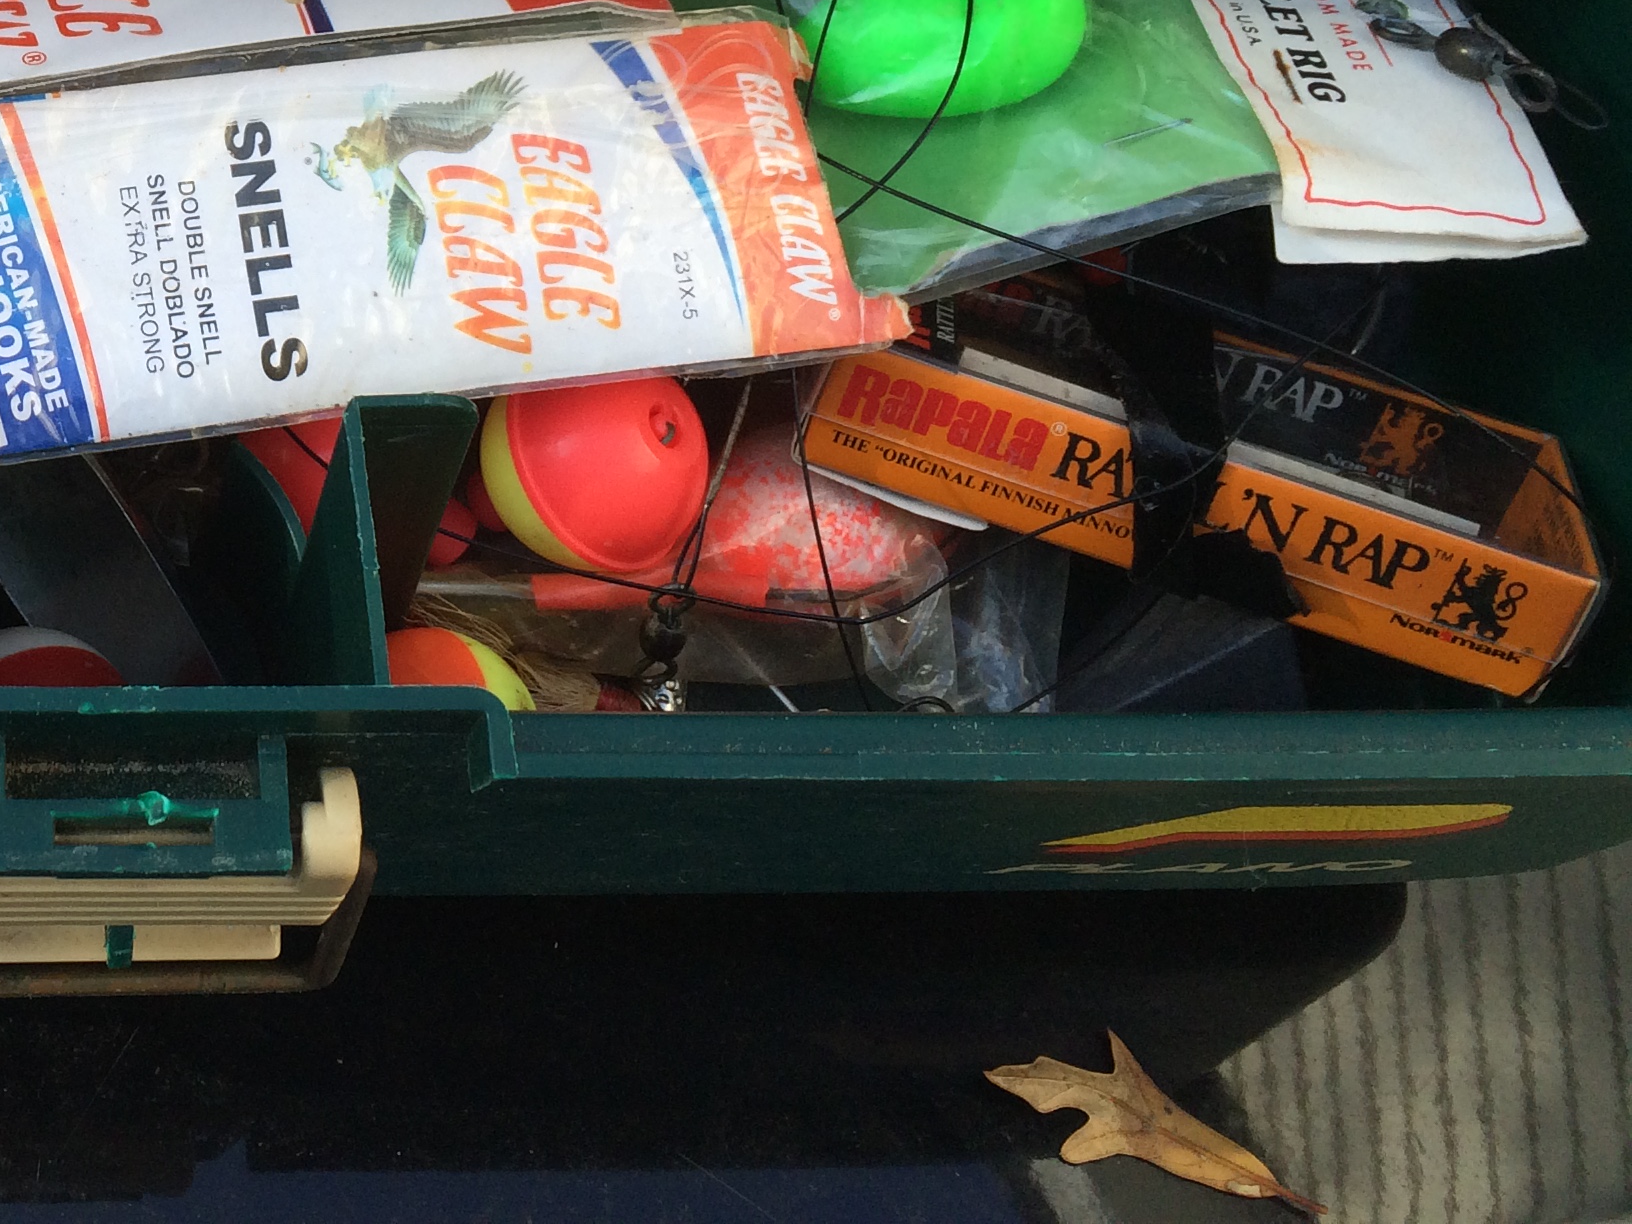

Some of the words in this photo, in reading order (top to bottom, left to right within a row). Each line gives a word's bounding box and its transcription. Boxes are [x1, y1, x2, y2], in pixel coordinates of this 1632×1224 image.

[1228, 2, 1244, 12] in
[1330, 22, 1374, 71] MADE
[1285, 47, 1347, 104] RIG
[737, 72, 807, 183] EAGLE
[119, 185, 149, 266] EXTRA
[146, 173, 174, 252] SNELL
[225, 120, 309, 383] SNELLS
[426, 164, 533, 355] CLAW
[511, 132, 622, 331] EAGLE
[769, 193, 838, 306] CLAW
[131, 272, 166, 375] STRONG
[159, 258, 195, 379] DOBLADO
[177, 179, 209, 281] DOUBLE
[193, 286, 223, 366] SNELL
[671, 251, 698, 321] 231X-5
[935, 288, 960, 344] RATTL
[836, 363, 1050, 472] Rapala
[1242, 362, 1345, 424] RAP
[831, 429, 871, 455] THE
[978, 479, 1061, 518] FINNISH
[1061, 505, 1135, 542] MINNO
[1303, 515, 1431, 591] RAP
